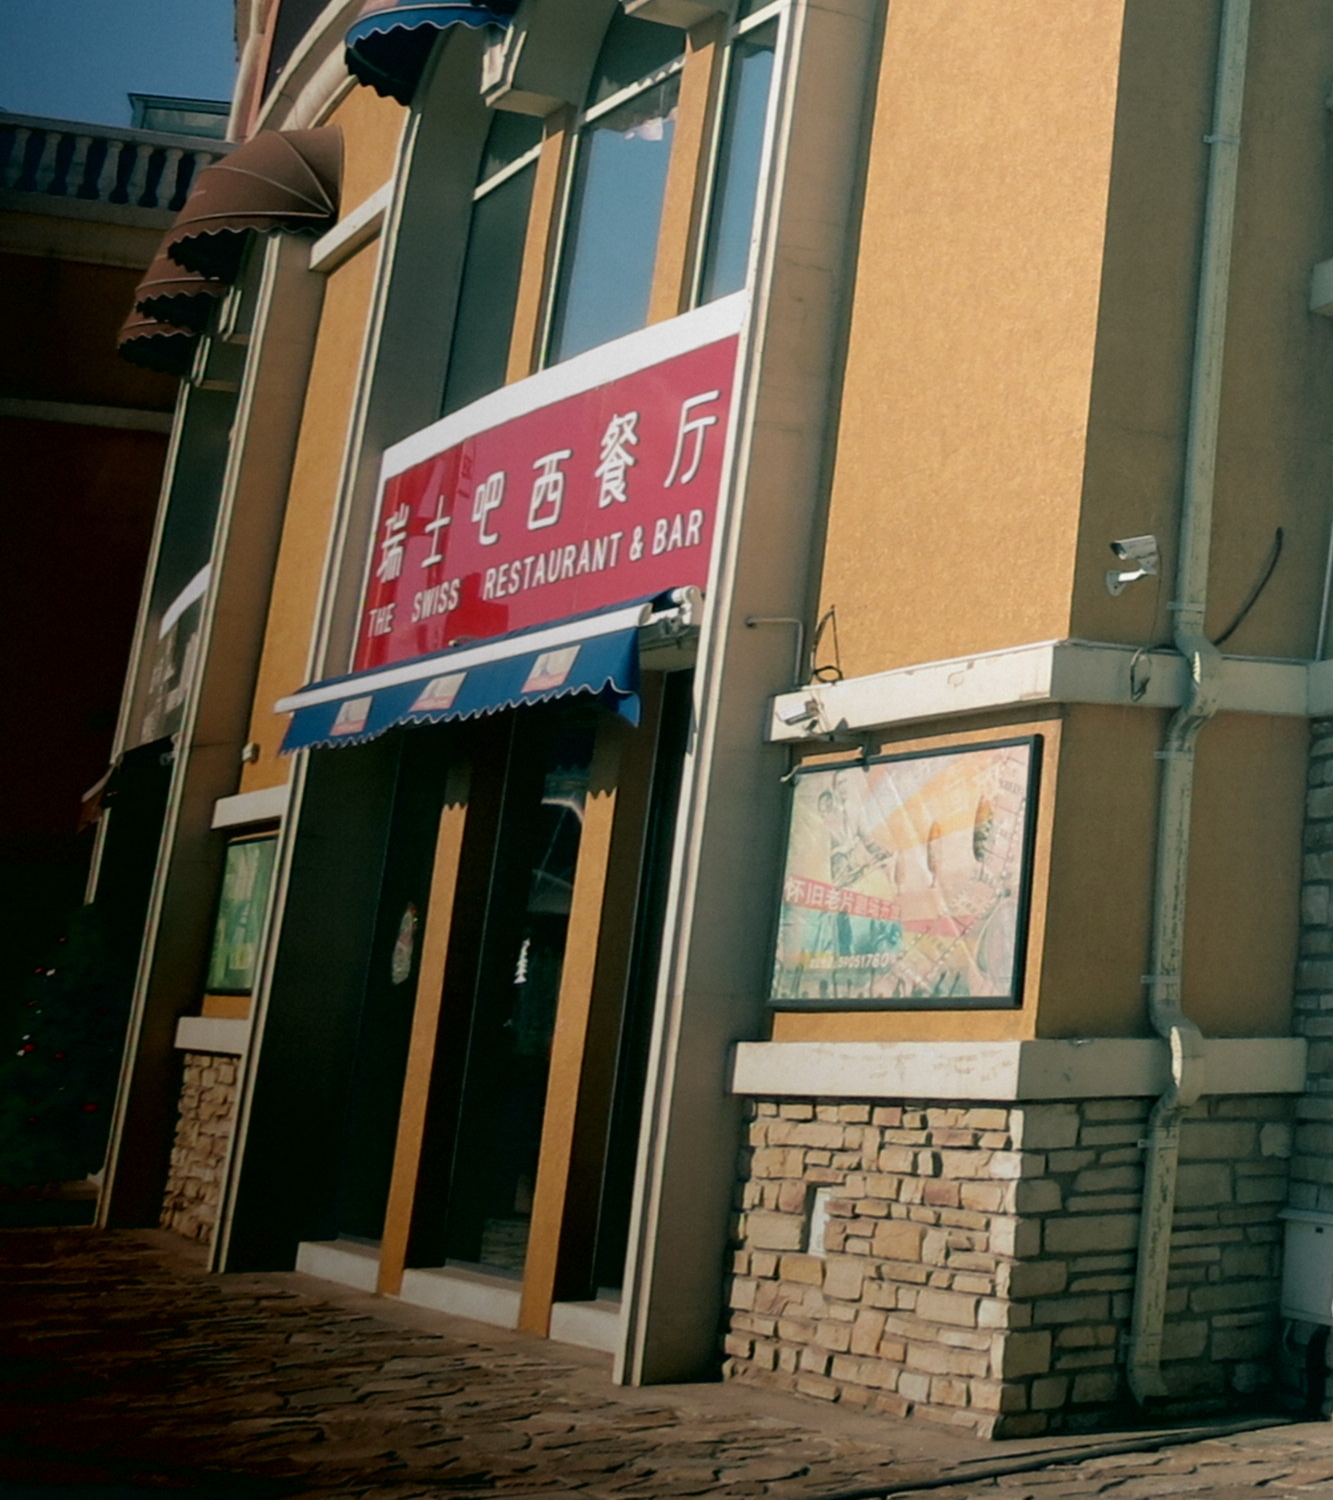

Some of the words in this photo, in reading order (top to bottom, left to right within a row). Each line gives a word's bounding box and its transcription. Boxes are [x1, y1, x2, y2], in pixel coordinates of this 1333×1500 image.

[376, 389, 720, 584] 瑞士吧西餐厅
[368, 602, 396, 638] THE
[411, 578, 462, 624] SWISS
[483, 531, 624, 601] RESTAURANT
[629, 525, 646, 562] &
[652, 508, 704, 556] BAR
